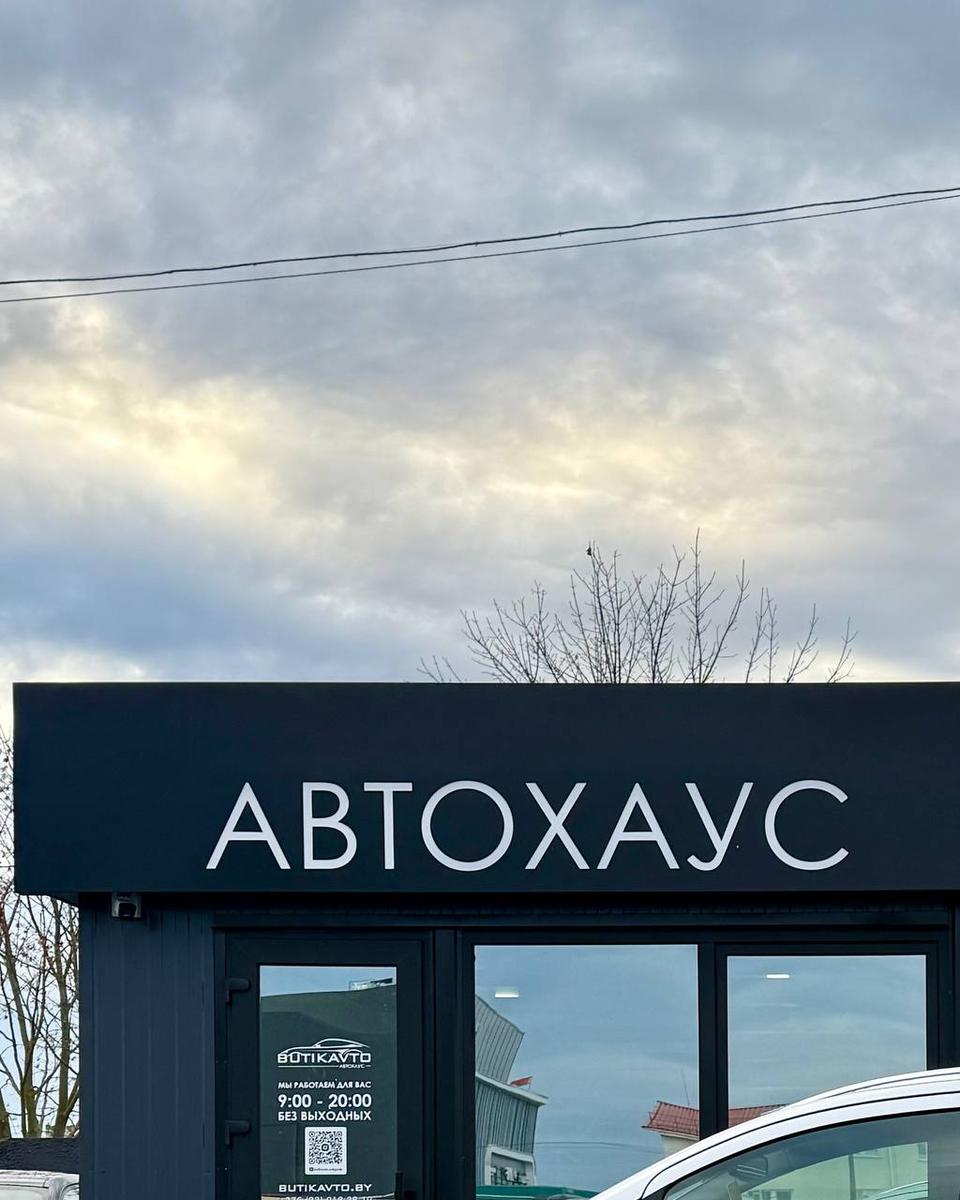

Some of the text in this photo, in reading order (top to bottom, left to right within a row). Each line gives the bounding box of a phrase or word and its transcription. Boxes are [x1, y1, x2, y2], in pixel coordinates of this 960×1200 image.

[205, 780, 850, 873] АВТОХАУС
[277, 1052, 371, 1063] BUTIKAVTO
[278, 1081, 372, 1089] МЫ РАБОТАЕМ ДЛЯ ВАС
[278, 1093, 312, 1108] 9:00
[328, 1093, 372, 1108] 20:00
[278, 1110, 372, 1122] БЕЗ ВЫХОДНЫХ
[278, 1184, 373, 1192] BUTIKAVTO.BY
